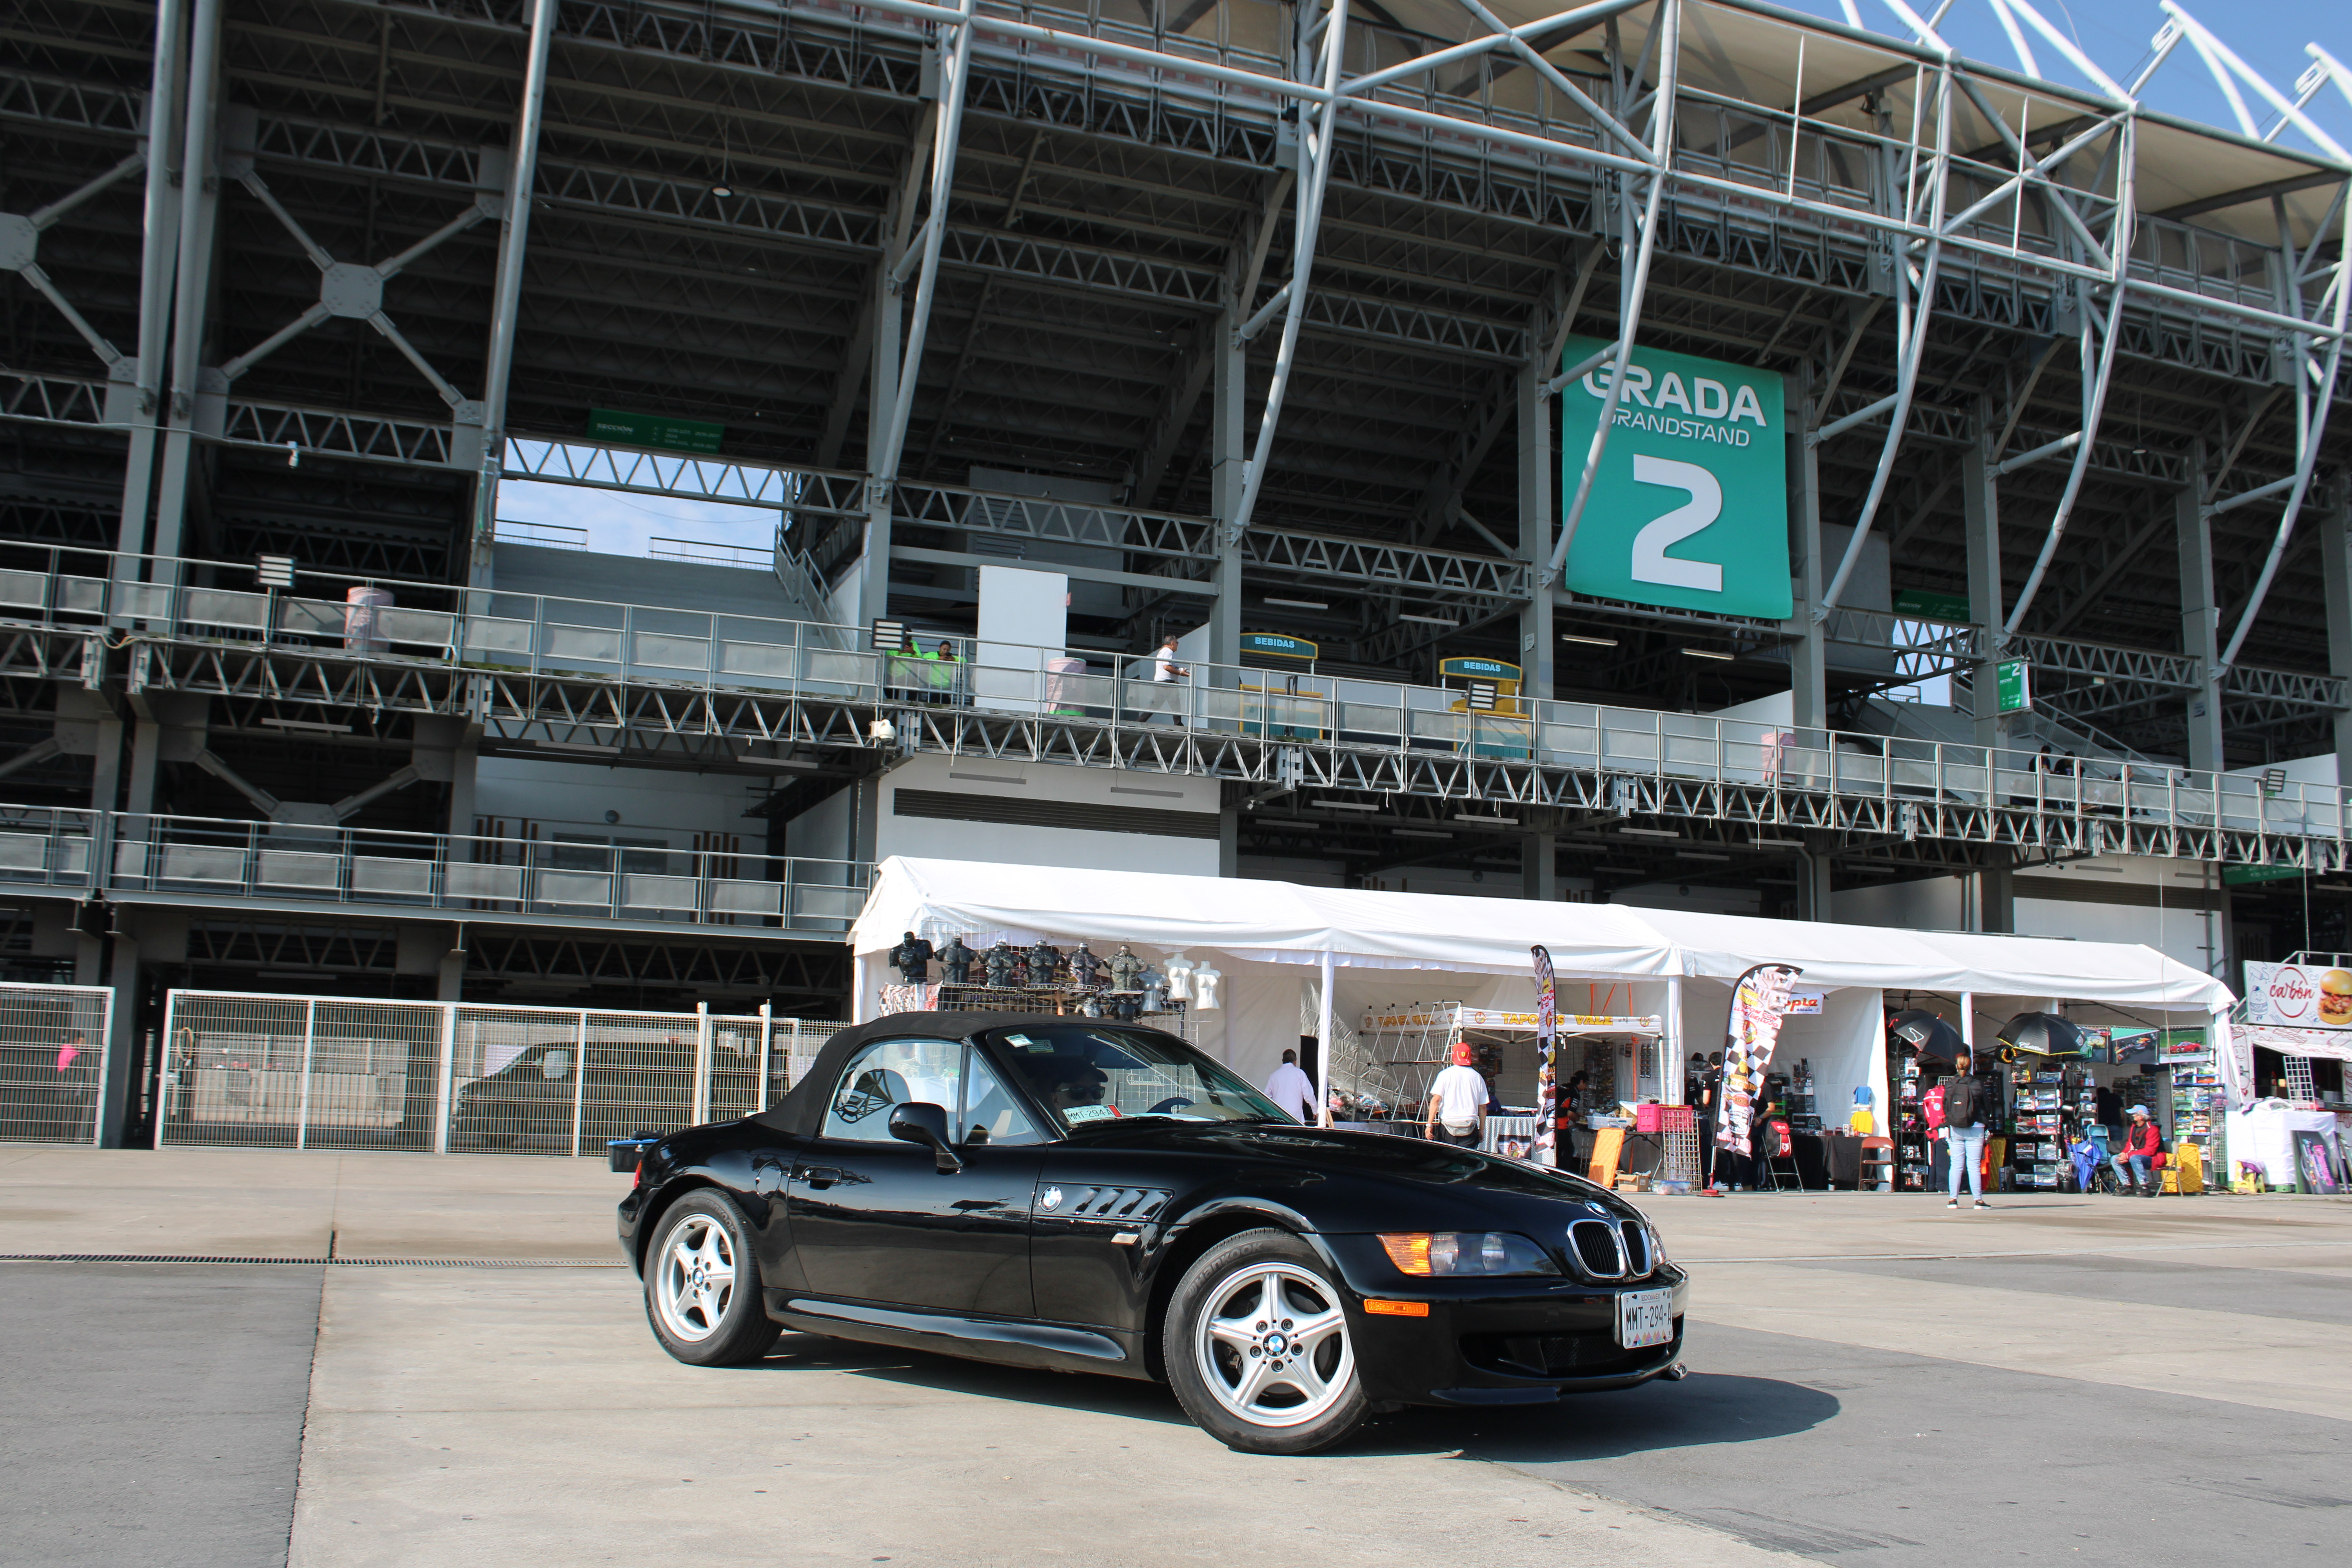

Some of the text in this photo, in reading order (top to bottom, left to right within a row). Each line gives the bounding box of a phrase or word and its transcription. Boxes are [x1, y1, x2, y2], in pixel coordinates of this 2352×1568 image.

[1631, 454, 1722, 592] 2
[1255, 637, 1295, 648] BEBIDAS
[1464, 661, 1501, 672] BEBIDAS
[2012, 662, 2020, 676] 2
[2270, 979, 2315, 999] carbón
[1501, 1013, 1613, 1025] TAPOS VALE
[2019, 1041, 2045, 1052] Cadillac
[1067, 1109, 1114, 1121] MMT-294-A
[1626, 1302, 1671, 1331] MMT-294-A
